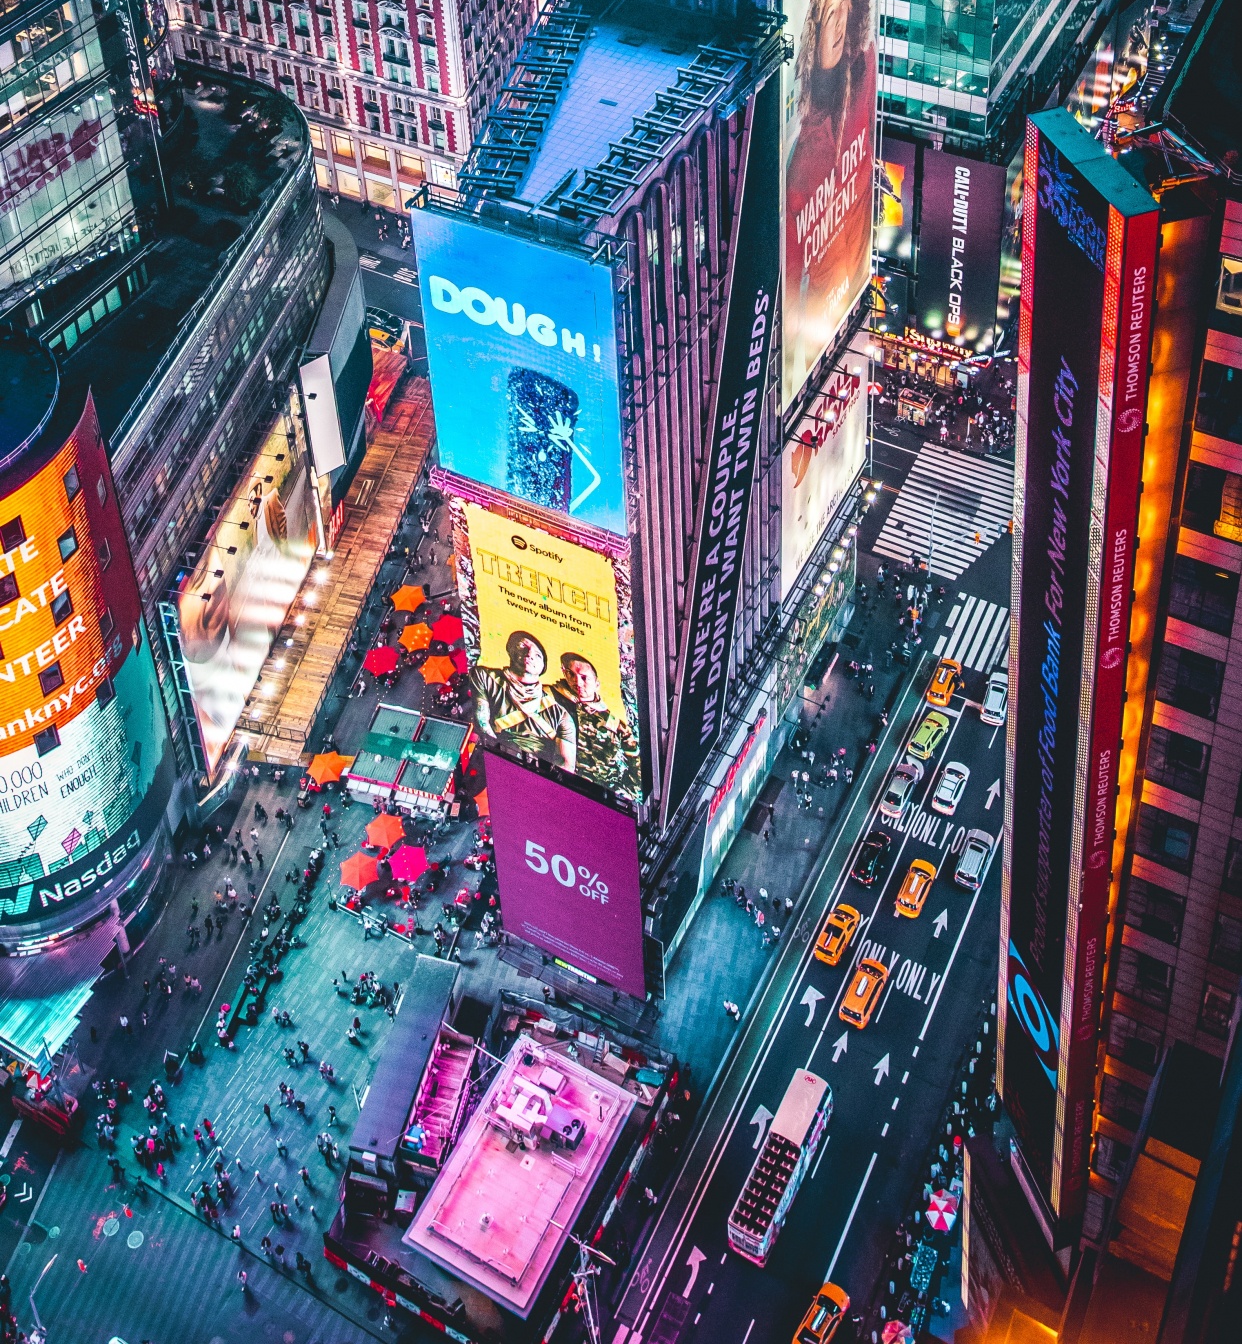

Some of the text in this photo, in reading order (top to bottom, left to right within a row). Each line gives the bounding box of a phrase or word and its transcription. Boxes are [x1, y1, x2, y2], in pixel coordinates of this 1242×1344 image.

[796, 168, 838, 244] WARM.
[841, 127, 866, 184] DRY.
[951, 199, 969, 235] DUTY
[804, 172, 858, 269] CONTENT.
[950, 237, 965, 292] BLACK
[947, 293, 962, 325] OPS
[1126, 266, 1147, 402] THOMSON REUTERS
[734, 387, 758, 479] TWIN
[709, 398, 739, 538] COUPLE.
[529, 543, 564, 564] Spotify
[705, 541, 721, 566] A
[720, 487, 745, 584] WANT
[816, 514, 827, 536] THE
[476, 547, 611, 623] TRENCH
[497, 584, 592, 630] The new album from
[506, 598, 539, 618] twenty
[1108, 528, 1128, 643] THOMSON REUTERS
[707, 590, 732, 687] DON'T
[1030, 355, 1079, 974] Proud supporter of Food Bank For New York City
[700, 689, 719, 746] WE
[55, 765, 75, 782] WHO
[1093, 749, 1111, 847] THOMSON REUTERS
[912, 811, 955, 850] ONLY
[39, 828, 141, 908] Nasdaq
[579, 884, 610, 906] OFF
[895, 959, 942, 1005] ONLY
[1081, 937, 1097, 1022] THOMSON REUTERS
